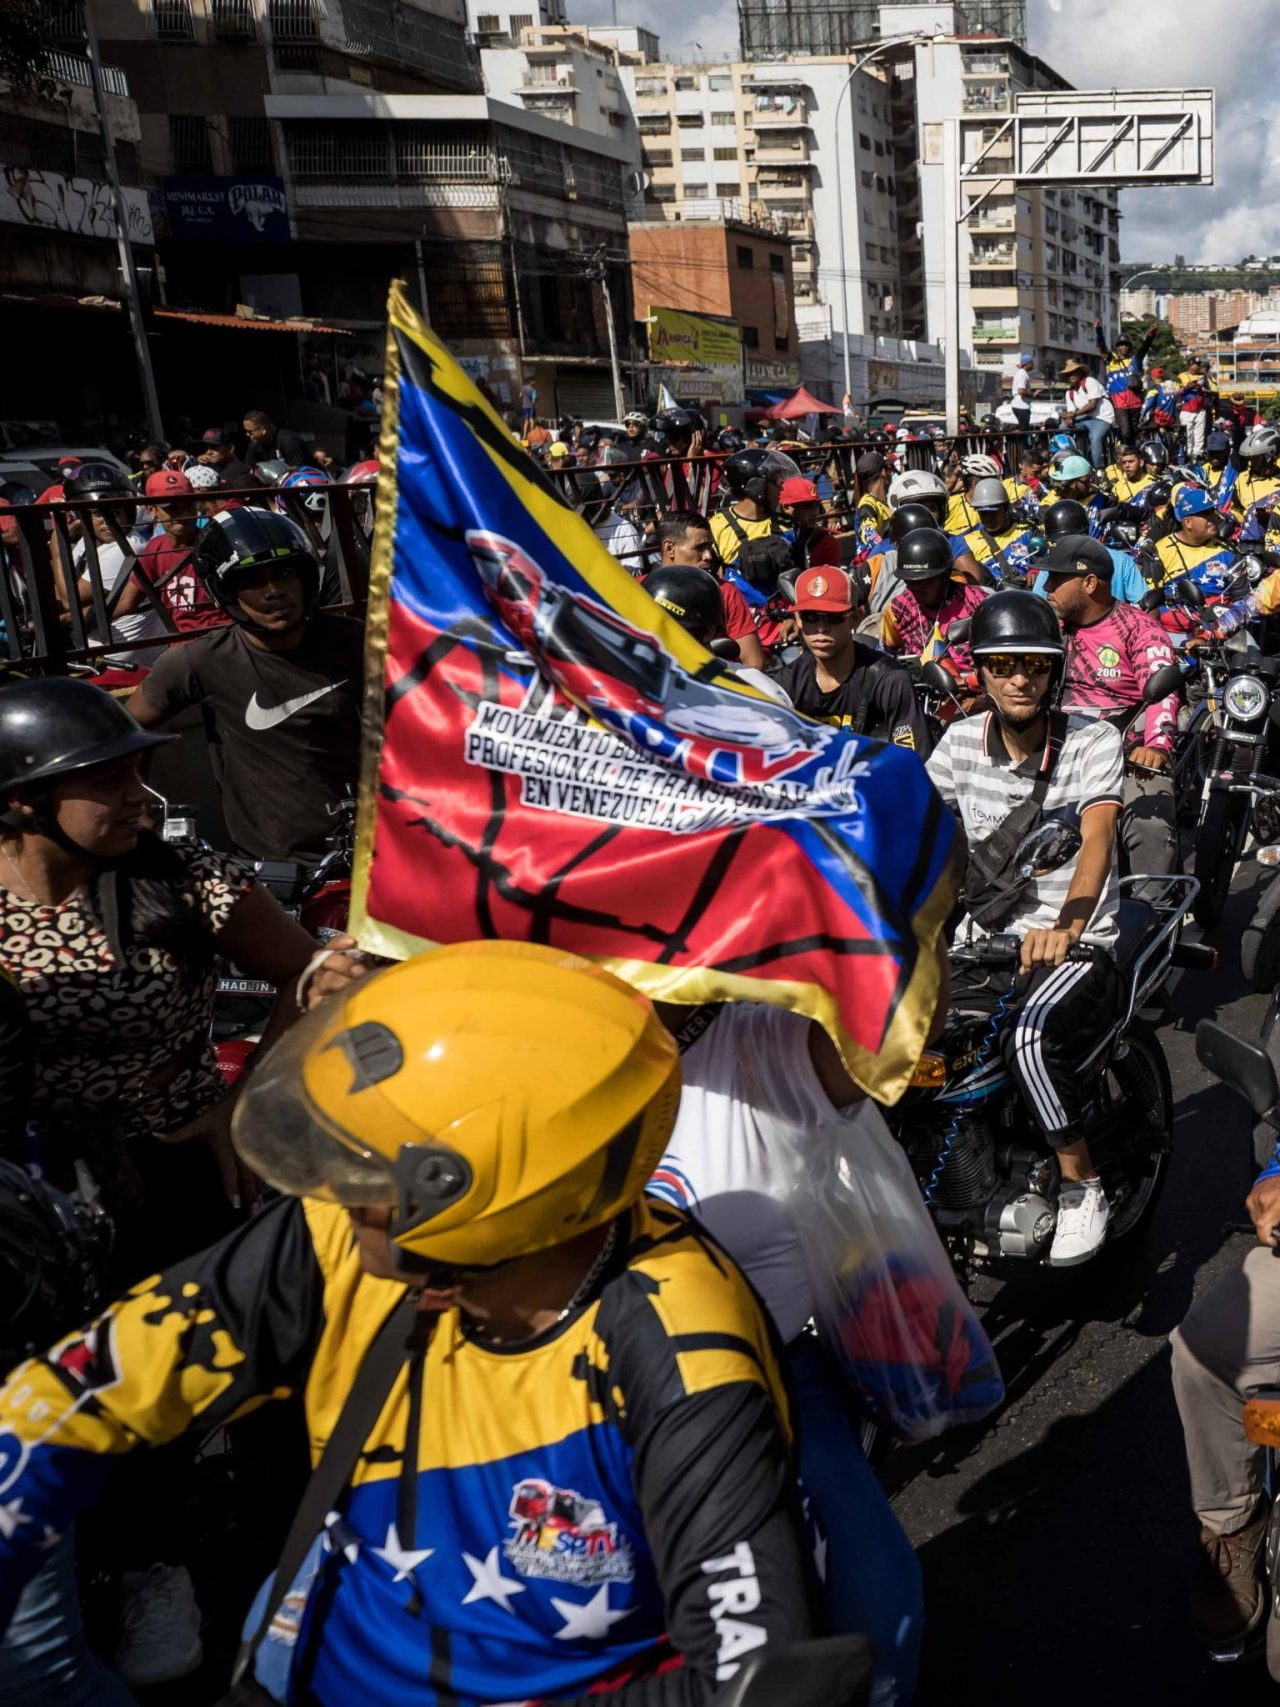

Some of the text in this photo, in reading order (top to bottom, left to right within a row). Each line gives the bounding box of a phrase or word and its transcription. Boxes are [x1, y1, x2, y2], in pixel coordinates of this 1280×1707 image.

[166, 190, 224, 202] MINIMARKET
[228, 184, 286, 215] POLAR
[1096, 667, 1122, 678] 2001
[479, 706, 611, 757] MOVIMIENTO
[468, 733, 612, 787] PROFESIONAL
[615, 765, 649, 793] DE
[524, 776, 678, 831] EN VENEZUELA
